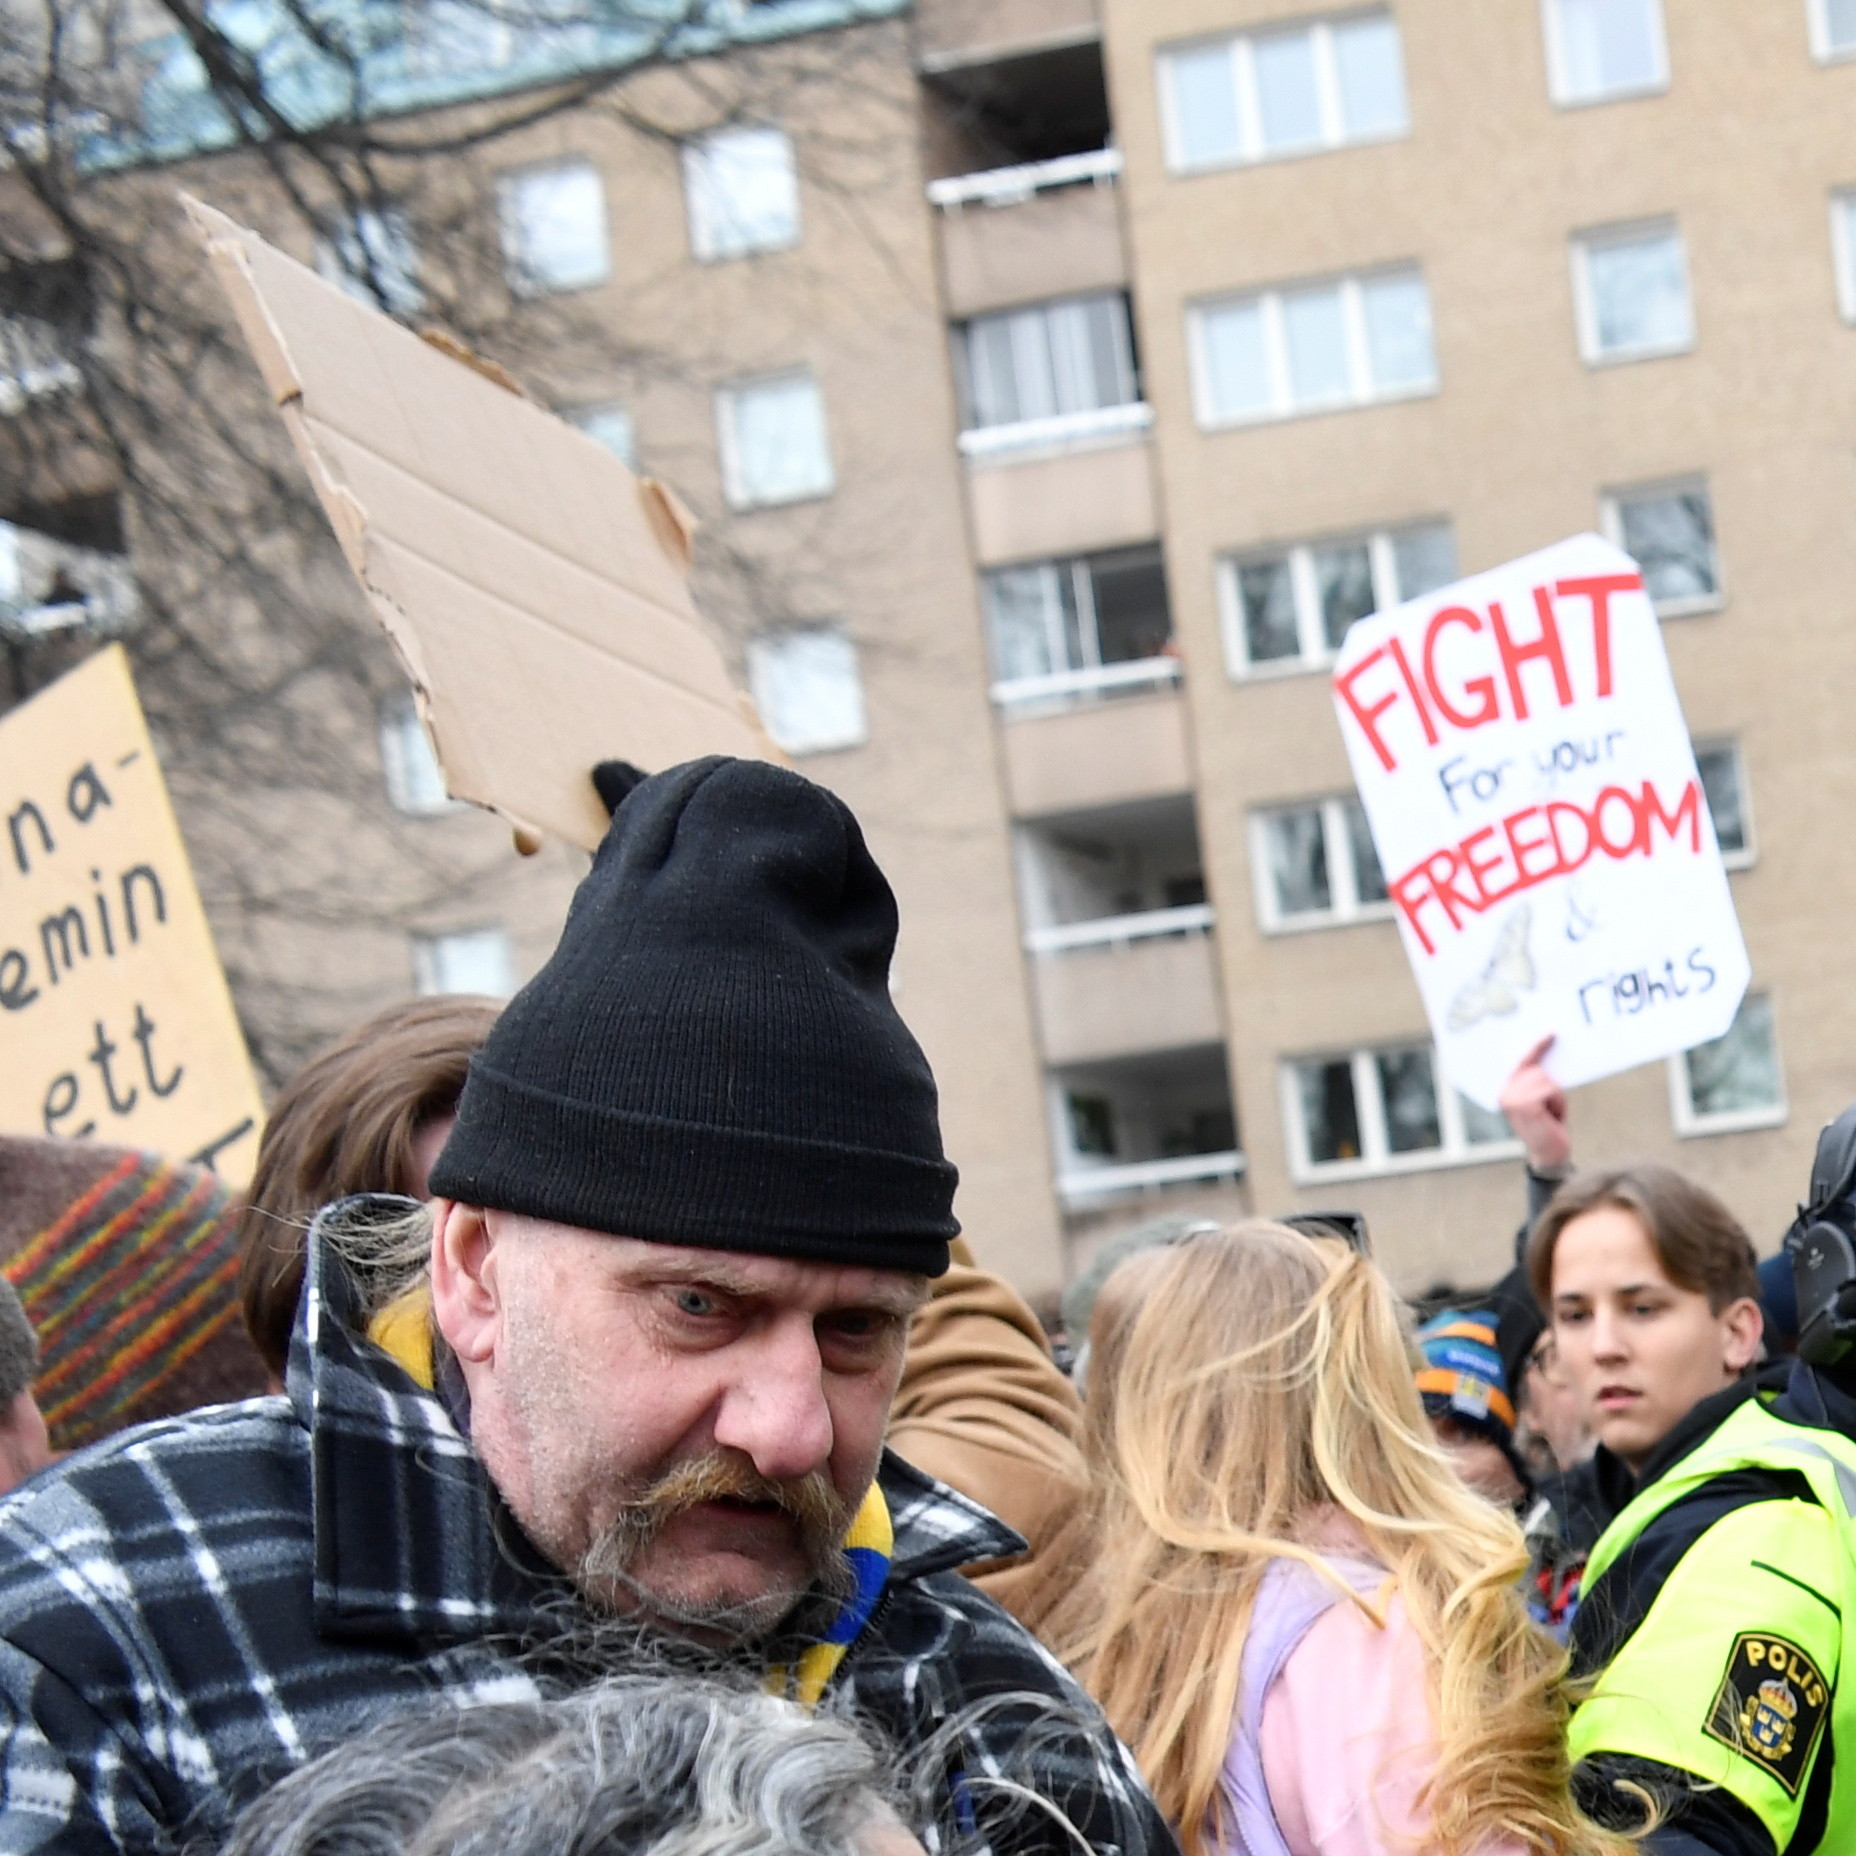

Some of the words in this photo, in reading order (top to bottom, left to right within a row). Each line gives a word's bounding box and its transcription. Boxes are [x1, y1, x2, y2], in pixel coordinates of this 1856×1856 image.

[1332, 573, 1644, 773] FIGHT
[1534, 729, 1628, 794] your
[1388, 778, 1703, 957] FREEDOM
[1578, 946, 1717, 1028] rights
[43, 1002, 184, 1138] ett
[1745, 1640, 1824, 1708] POLIS
